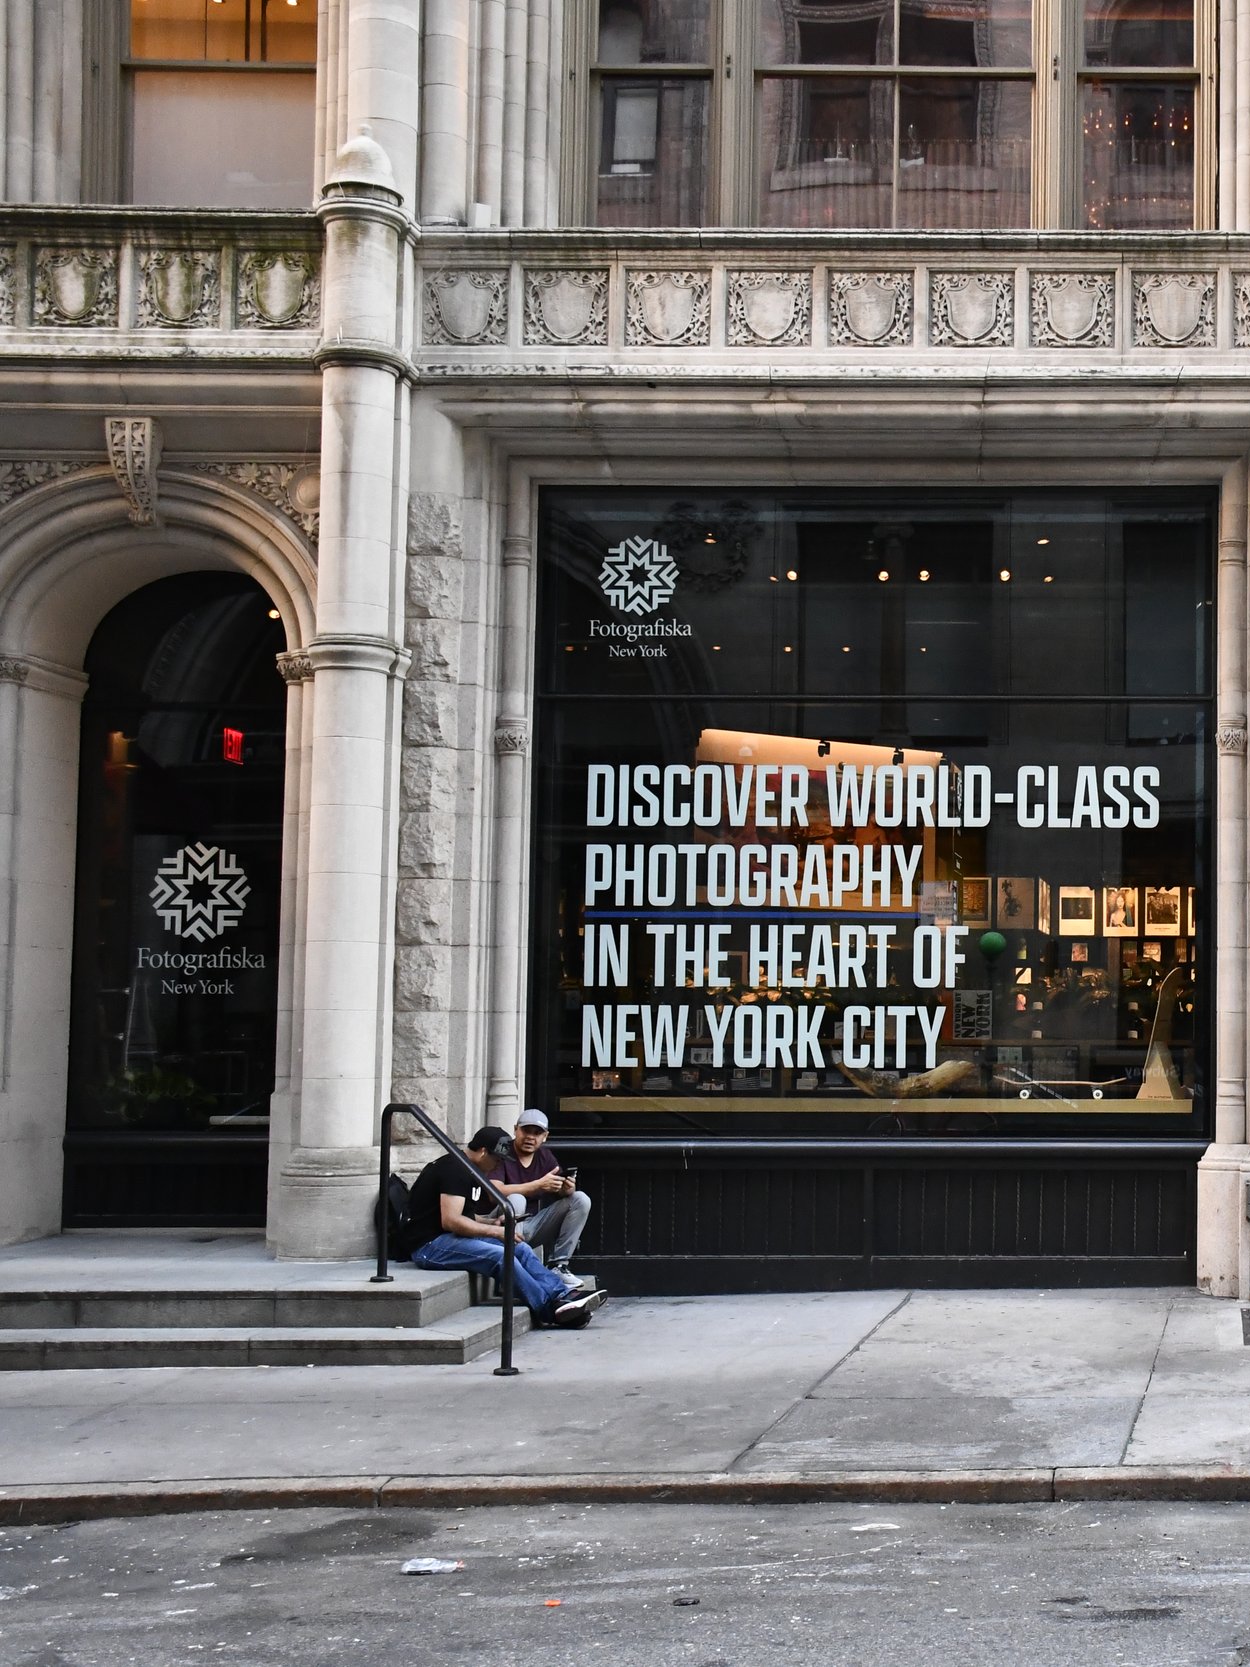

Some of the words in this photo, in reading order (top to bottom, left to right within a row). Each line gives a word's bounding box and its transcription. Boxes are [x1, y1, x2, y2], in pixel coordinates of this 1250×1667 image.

[589, 618, 692, 642] Fotografiska
[609, 645, 637, 657] New
[639, 644, 667, 657] York
[586, 764, 809, 827] DISCOVER
[826, 765, 1161, 828] WORLD-CLASS
[585, 844, 923, 907] PHOTOGRAPHY
[137, 946, 266, 976] Fotografiska
[583, 924, 629, 987] IN
[646, 924, 732, 987] THE
[749, 924, 897, 988] HEART
[913, 925, 969, 988] OF
[161, 979, 197, 995] New
[199, 979, 234, 995] York
[961, 1004, 976, 1038] NEW
[976, 993, 990, 1038] YORK
[581, 1005, 689, 1067] NEW
[704, 1005, 826, 1068] YORK
[843, 1005, 946, 1069] CITY
